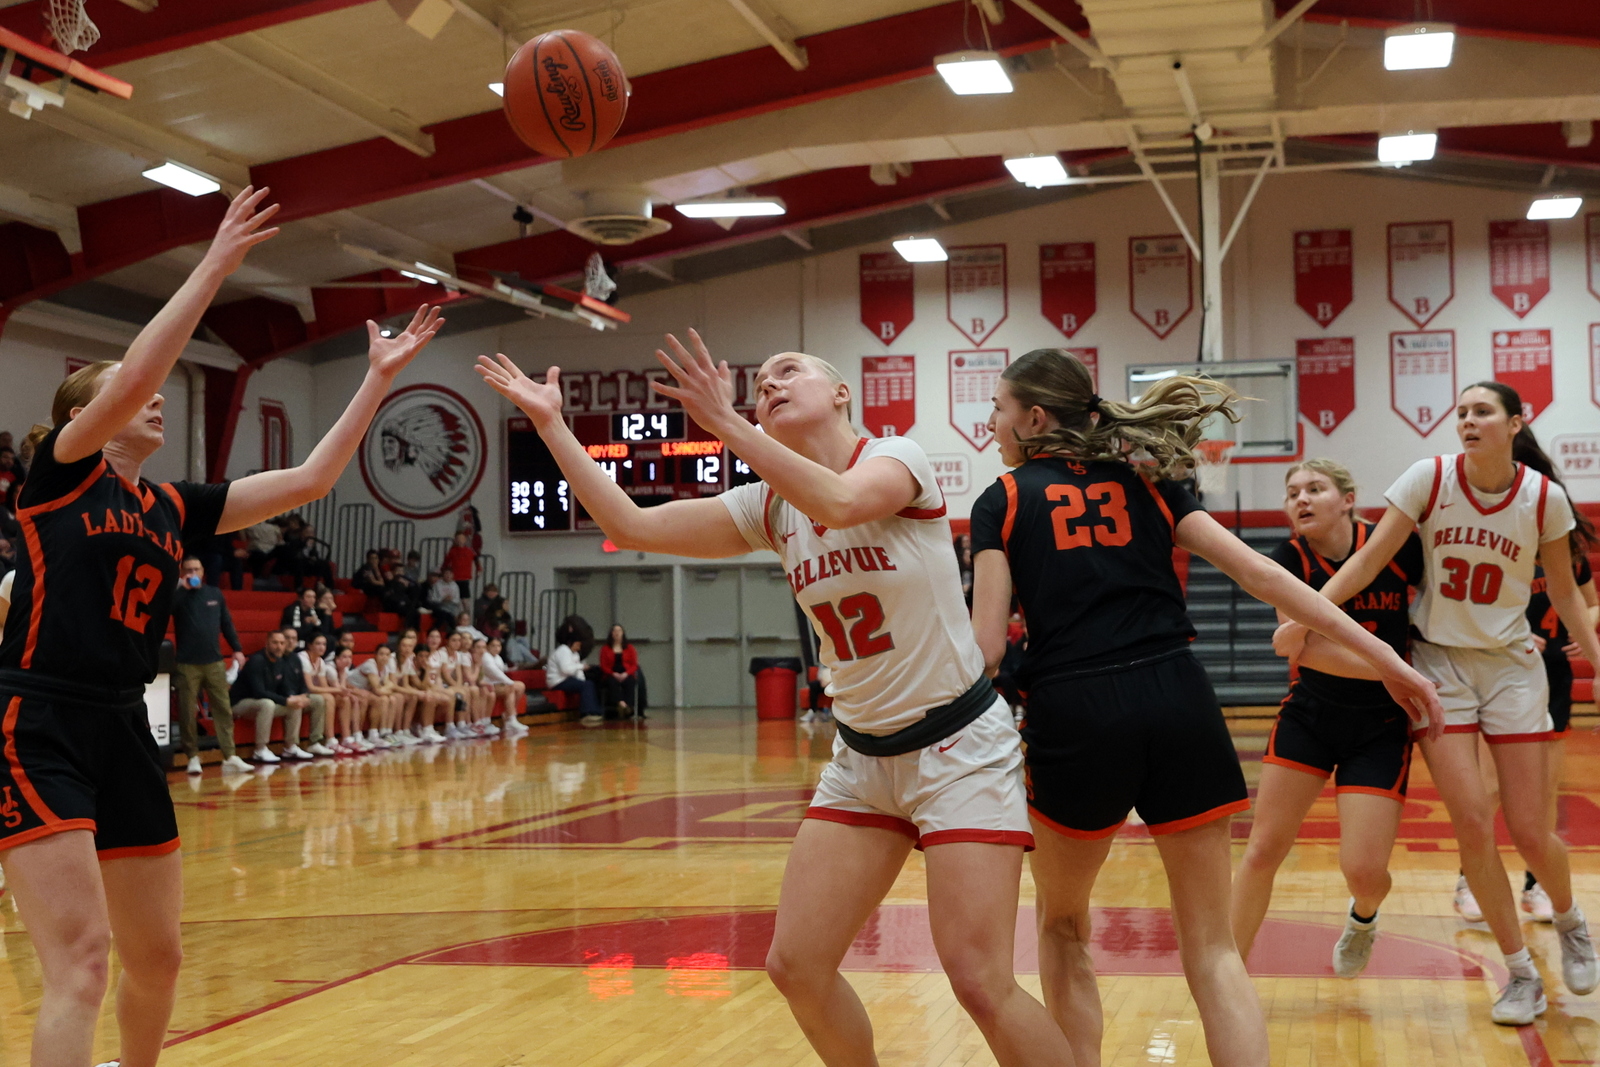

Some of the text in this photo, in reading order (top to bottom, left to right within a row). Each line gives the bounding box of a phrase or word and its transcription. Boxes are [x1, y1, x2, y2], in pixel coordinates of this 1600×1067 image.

[542, 56, 586, 131] Rawlings
[1414, 297, 1429, 315] B
[1513, 292, 1530, 312] B
[1154, 308, 1169, 326] B
[1317, 302, 1332, 321] B
[880, 321, 895, 339] B
[972, 318, 985, 334] B
[1062, 313, 1077, 331] B
[1318, 410, 1335, 428] B
[1417, 406, 1432, 424] B
[622, 414, 667, 440] 12.4
[973, 422, 988, 439] B
[661, 441, 723, 456] U.SANDUSKY
[649, 462, 655, 480] 1
[697, 456, 720, 483] 12
[511, 480, 568, 497] 30 0 2
[511, 498, 530, 514] 32
[539, 499, 545, 512] 1
[534, 515, 545, 529] 4
[1044, 481, 1133, 550] 23
[1433, 526, 1522, 563] BELLEVUE
[1440, 556, 1504, 605] 30
[109, 554, 163, 635] 12
[809, 591, 896, 662] 12
[1541, 605, 1559, 638] 4
